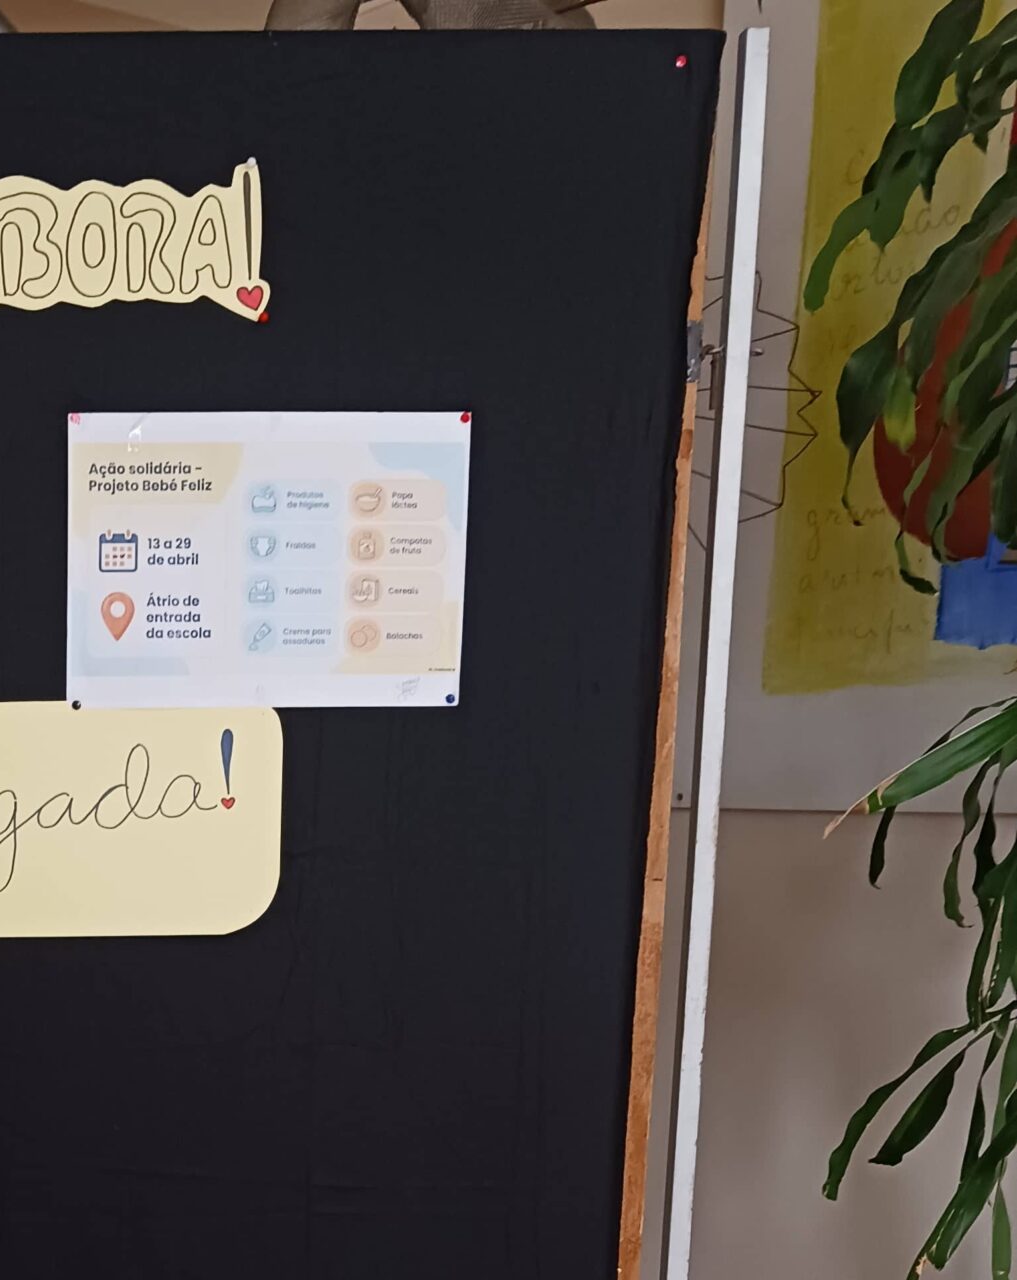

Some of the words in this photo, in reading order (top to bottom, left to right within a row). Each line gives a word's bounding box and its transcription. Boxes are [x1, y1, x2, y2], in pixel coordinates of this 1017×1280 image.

[88, 461, 126, 478] Ação
[128, 461, 192, 475] solidária
[88, 478, 139, 495] Projeto
[142, 478, 178, 491] Bebé
[180, 478, 213, 491] Feliz
[287, 491, 324, 499] Produtos
[391, 491, 414, 500] Papa
[299, 501, 330, 510] higiene
[147, 537, 161, 549] 13
[163, 540, 173, 549] a
[175, 537, 192, 549] 29
[285, 541, 316, 549] Fraldas
[390, 537, 432, 546] Compotas
[401, 546, 422, 554] fruta
[147, 553, 164, 565] de
[167, 552, 199, 565] abril
[388, 587, 419, 595] Cereais
[146, 592, 180, 606] Átrio
[182, 595, 200, 606] de
[146, 611, 201, 622] entrada
[146, 627, 164, 638] da
[167, 627, 212, 638] escola
[283, 628, 311, 636] Creme
[312, 628, 332, 637] para
[386, 632, 424, 640] Bolachas
